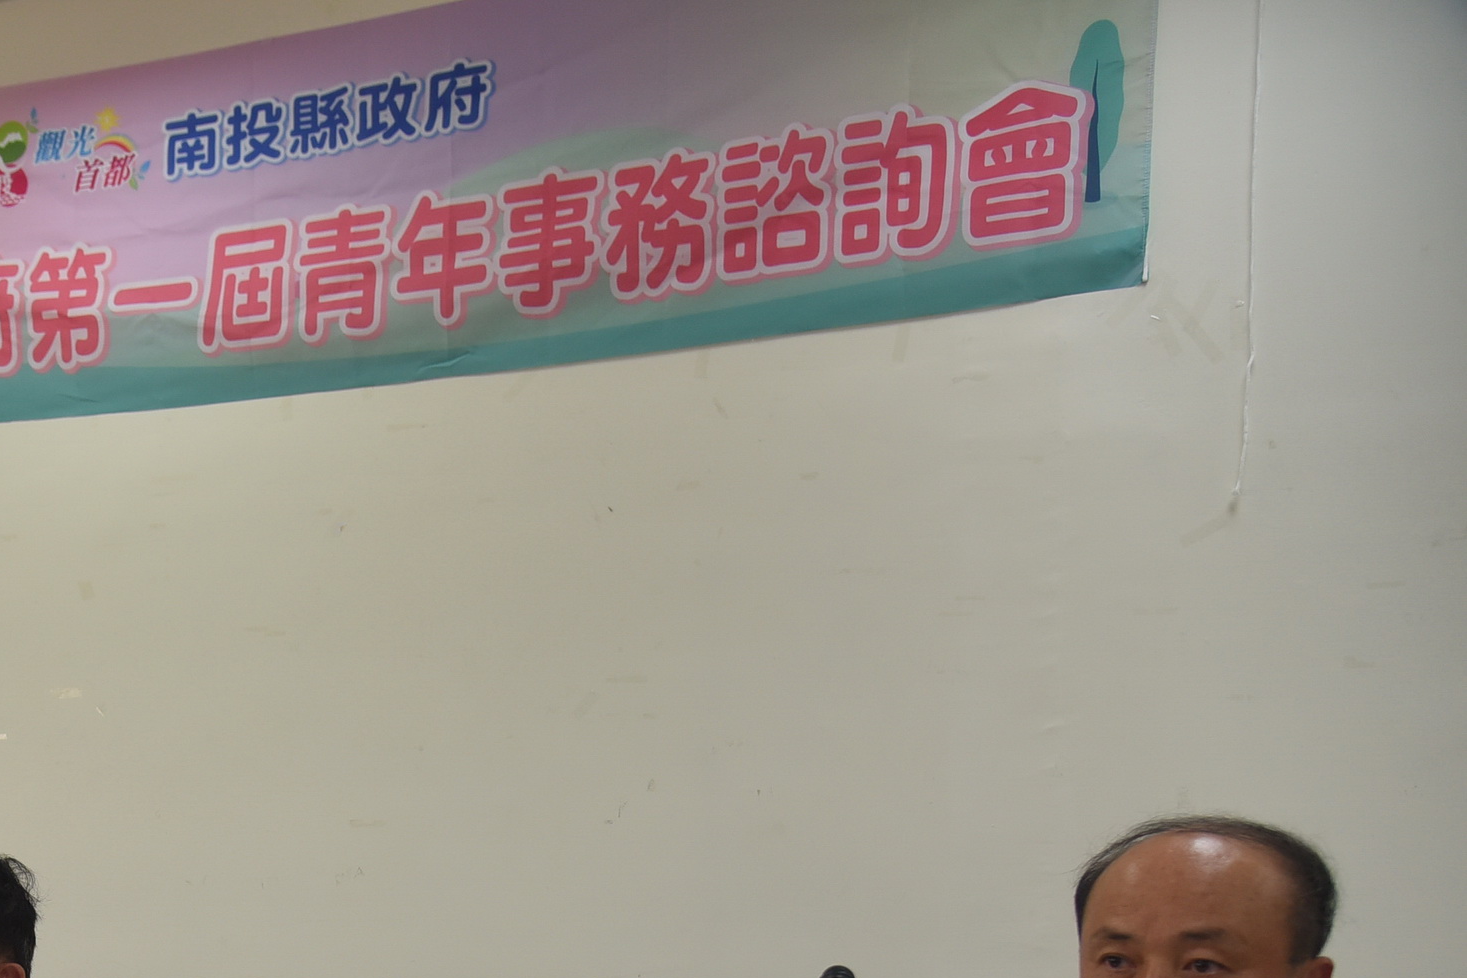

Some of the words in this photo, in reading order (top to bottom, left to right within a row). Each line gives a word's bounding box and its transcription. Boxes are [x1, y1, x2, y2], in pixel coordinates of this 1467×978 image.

[165, 60, 490, 176] 南投縣政府
[34, 126, 95, 164] 觀光
[75, 153, 135, 193] 首都
